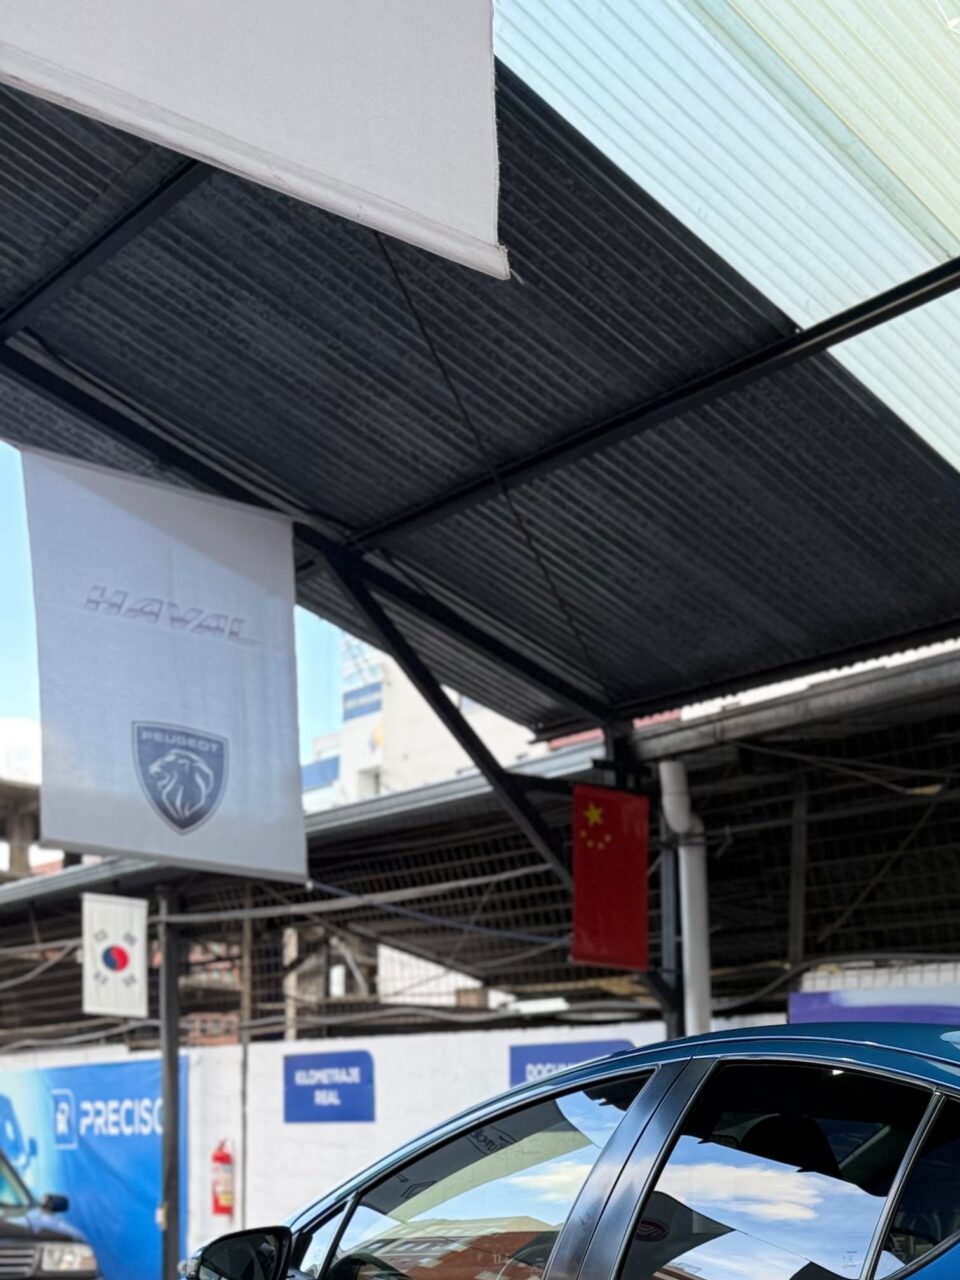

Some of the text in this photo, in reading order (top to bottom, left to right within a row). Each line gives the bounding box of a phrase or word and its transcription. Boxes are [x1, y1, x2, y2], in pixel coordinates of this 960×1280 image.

[85, 584, 263, 647] HAVAL
[141, 731, 219, 752] PEUGEOT
[313, 1088, 342, 1106] REAL
